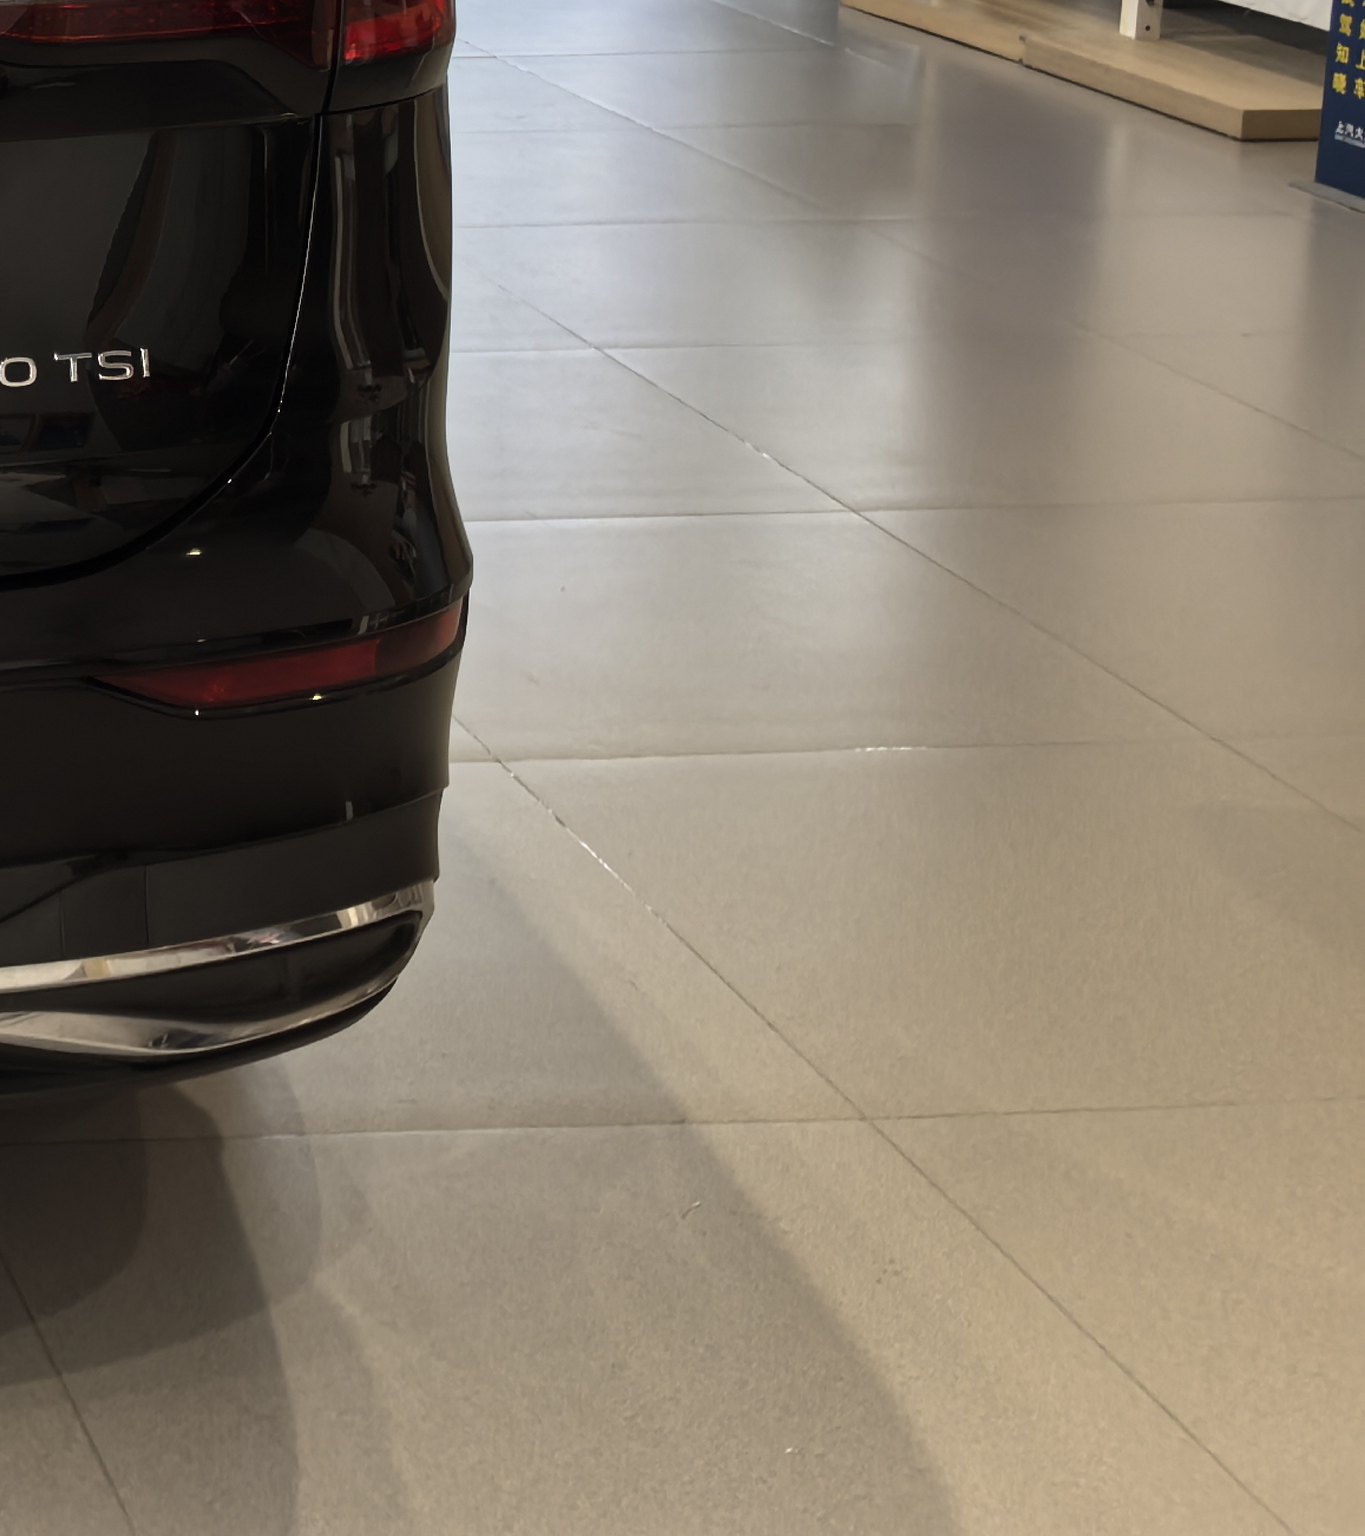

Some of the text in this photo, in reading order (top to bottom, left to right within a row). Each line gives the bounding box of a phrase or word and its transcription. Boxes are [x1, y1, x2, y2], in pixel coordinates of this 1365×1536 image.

[1334, 120, 1365, 142] 上汽大
[54, 347, 150, 383] TSI
